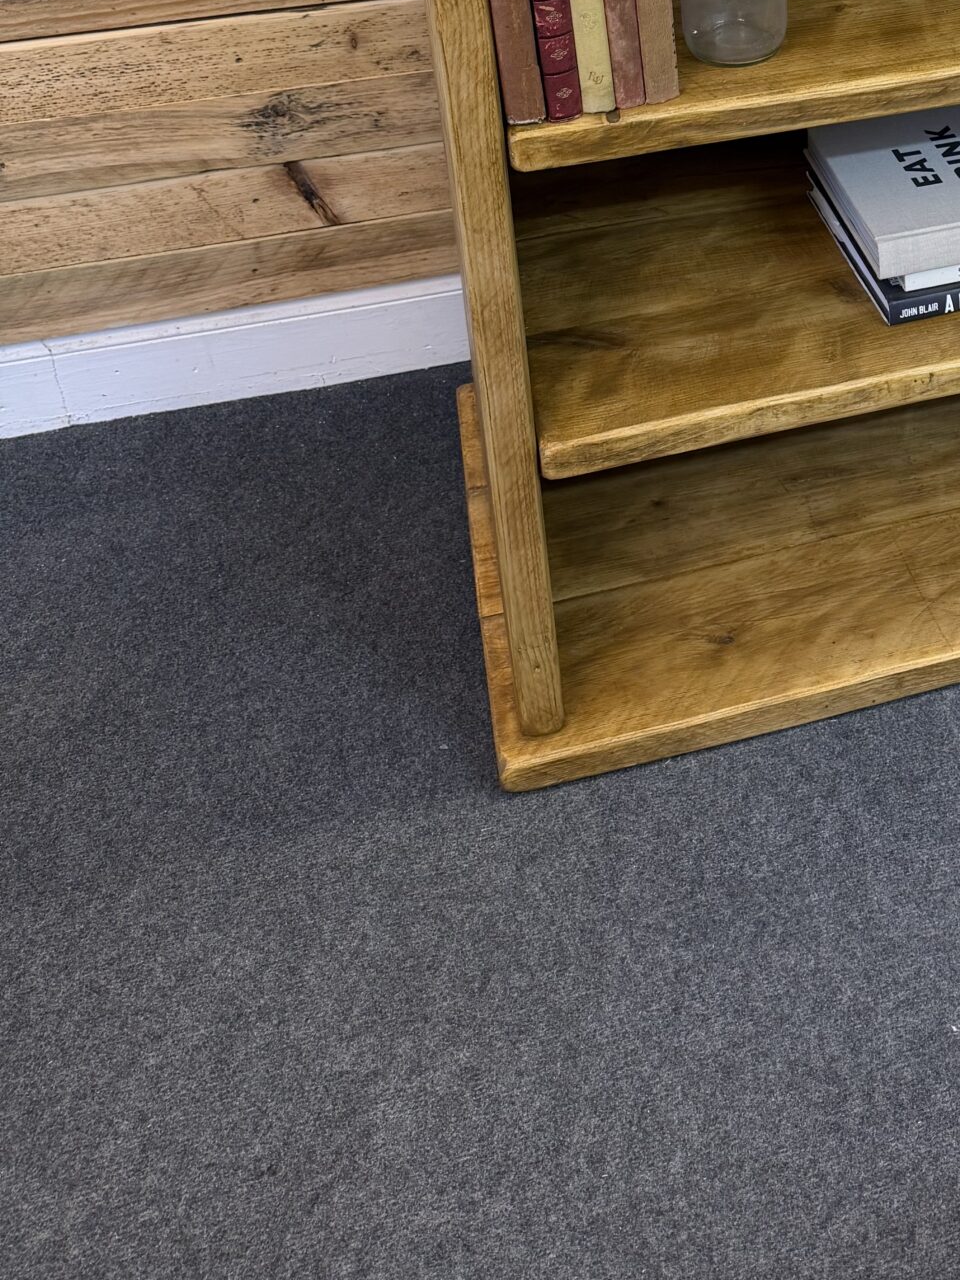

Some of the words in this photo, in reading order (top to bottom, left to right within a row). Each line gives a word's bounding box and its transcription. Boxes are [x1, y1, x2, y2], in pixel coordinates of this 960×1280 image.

[891, 148, 943, 188] EAT
[899, 307, 918, 319] JOHN
[919, 302, 939, 314] BLAIR
[944, 293, 955, 314] A
